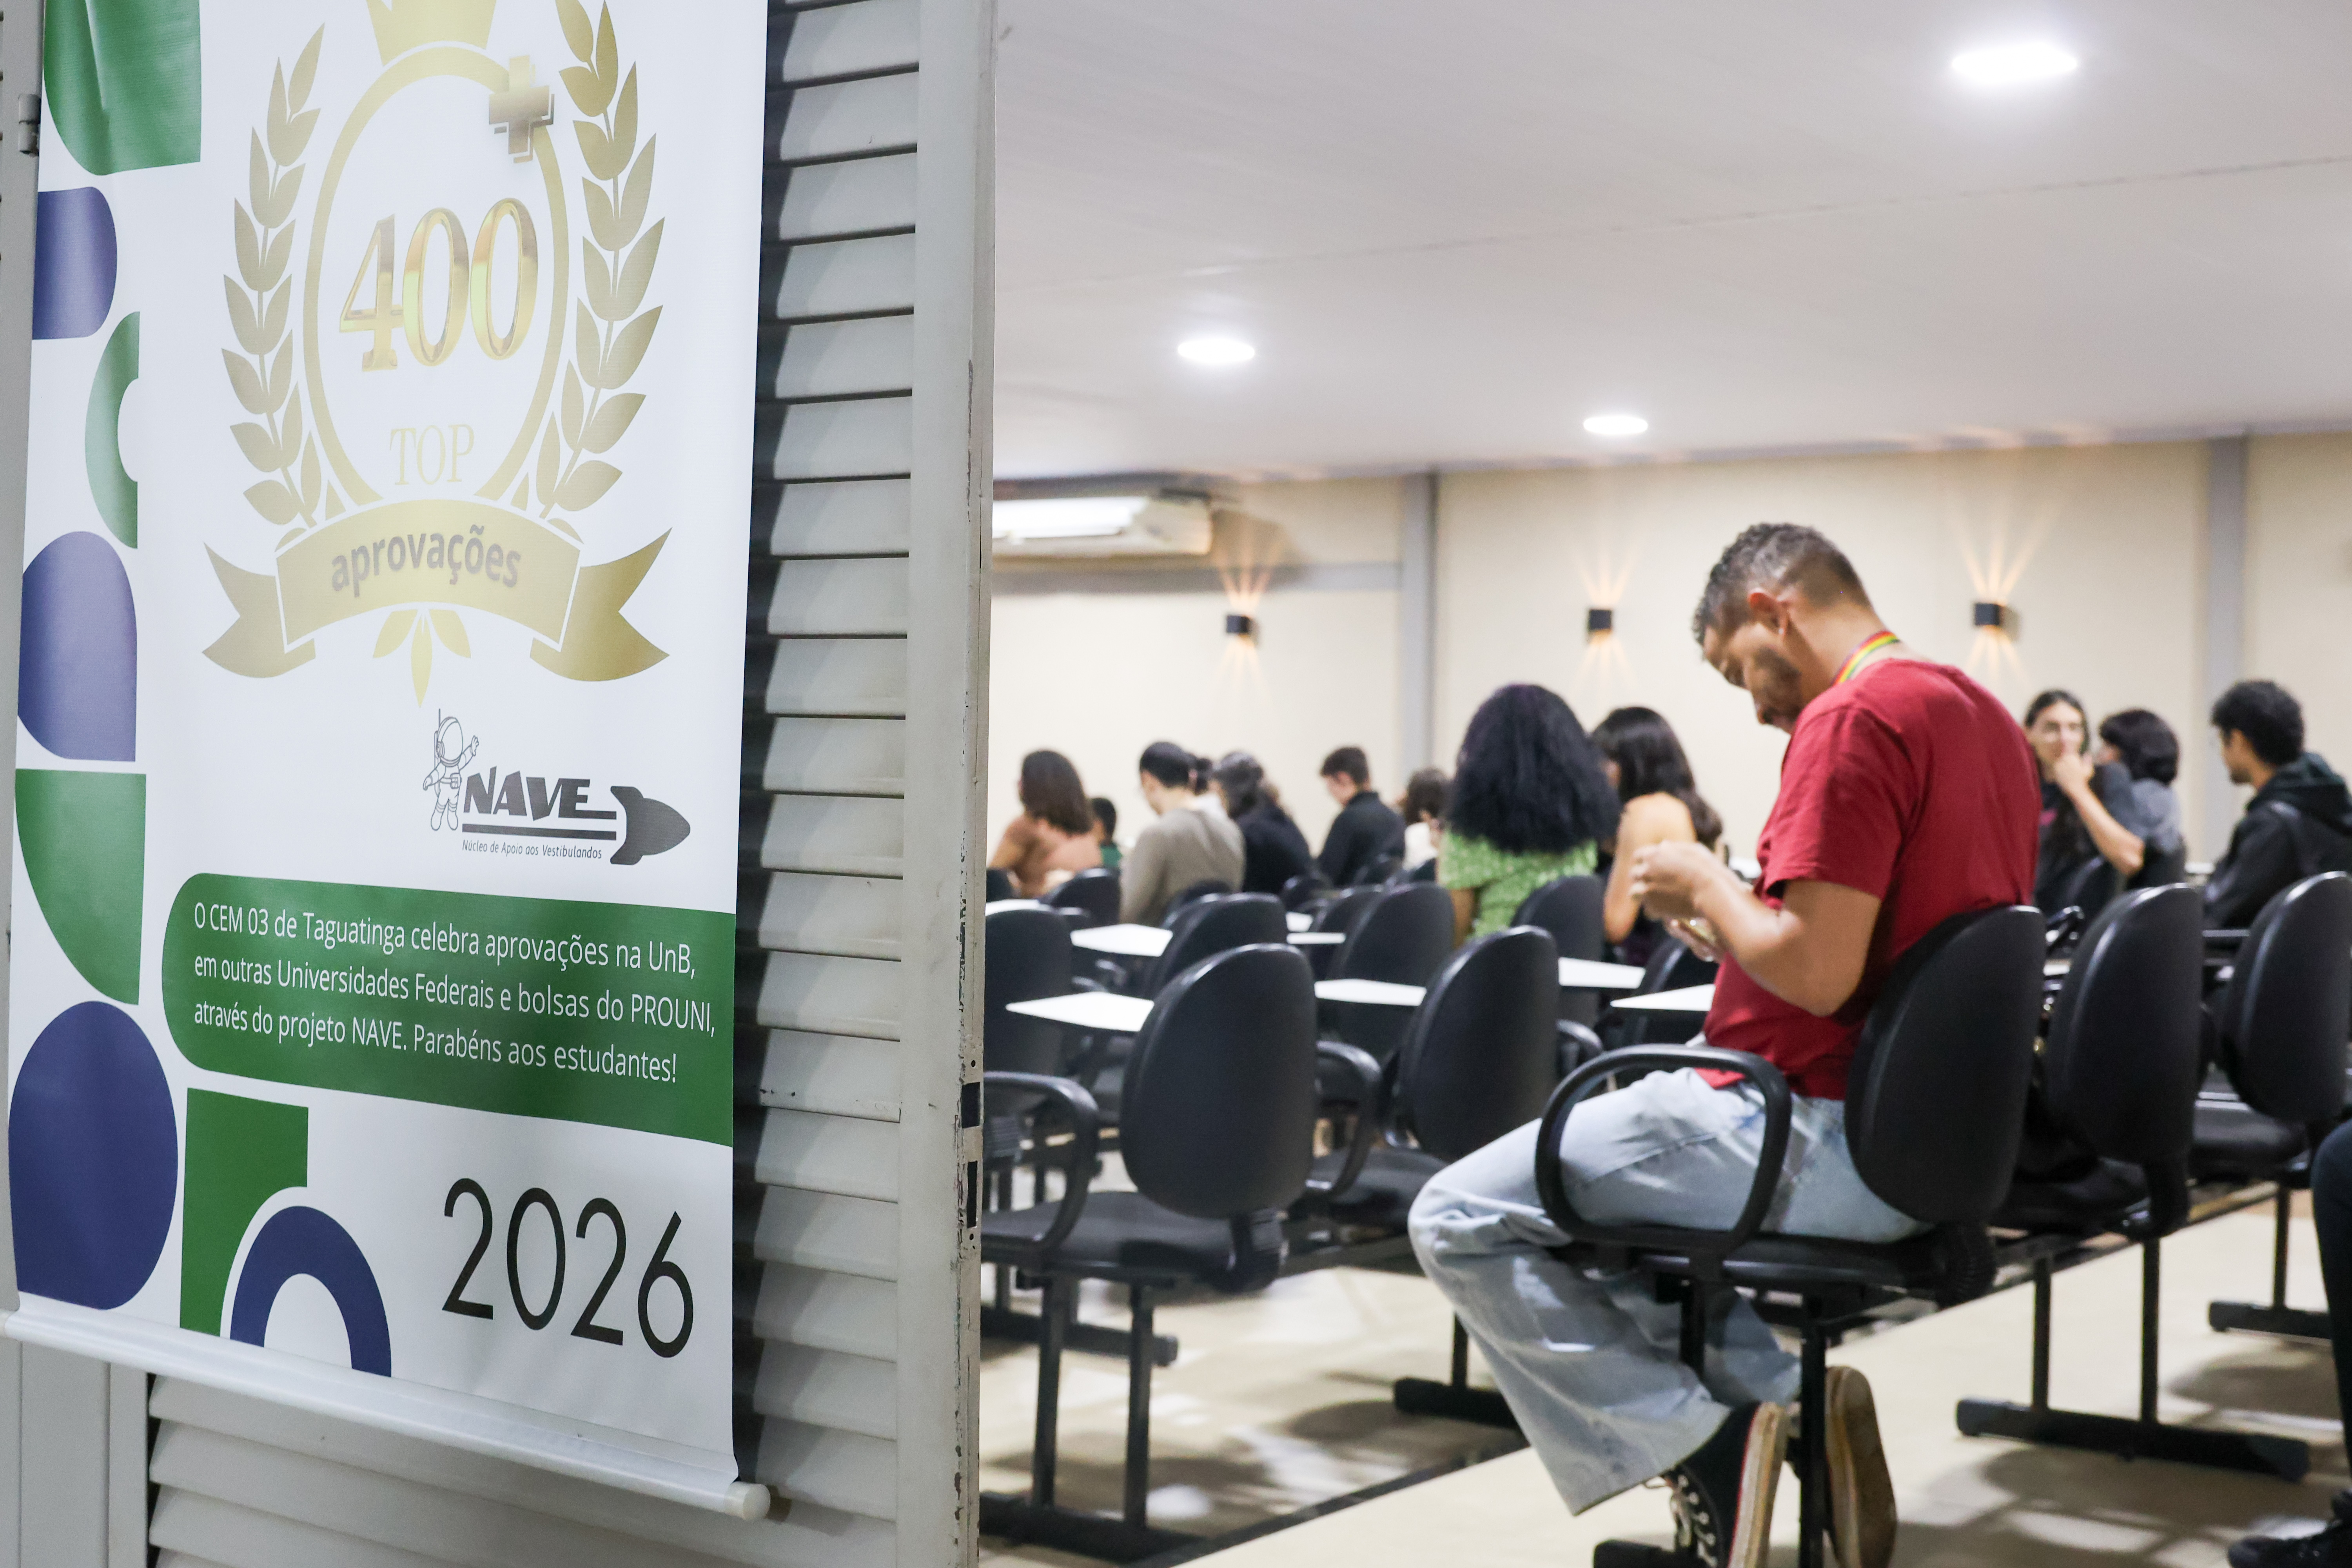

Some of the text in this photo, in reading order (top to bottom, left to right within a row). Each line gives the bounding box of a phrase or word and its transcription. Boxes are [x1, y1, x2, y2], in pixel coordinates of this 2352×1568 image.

[340, 199, 538, 372] 400
[390, 423, 475, 486] TOP
[332, 524, 522, 597] aprovações
[464, 767, 617, 821] NAVE
[463, 840, 602, 859] Núcleo de Apoio aos Vestibulandos
[195, 902, 694, 978] O CEM 03 de Taguatinga celebra aprovações na UnB,
[195, 956, 714, 1037] em outras Universidades Federais e bolsas do PROUNI,
[195, 1001, 676, 1082] através do projeto NAVE. Parabéns aos estudantes!
[442, 1178, 693, 1358] 2026
